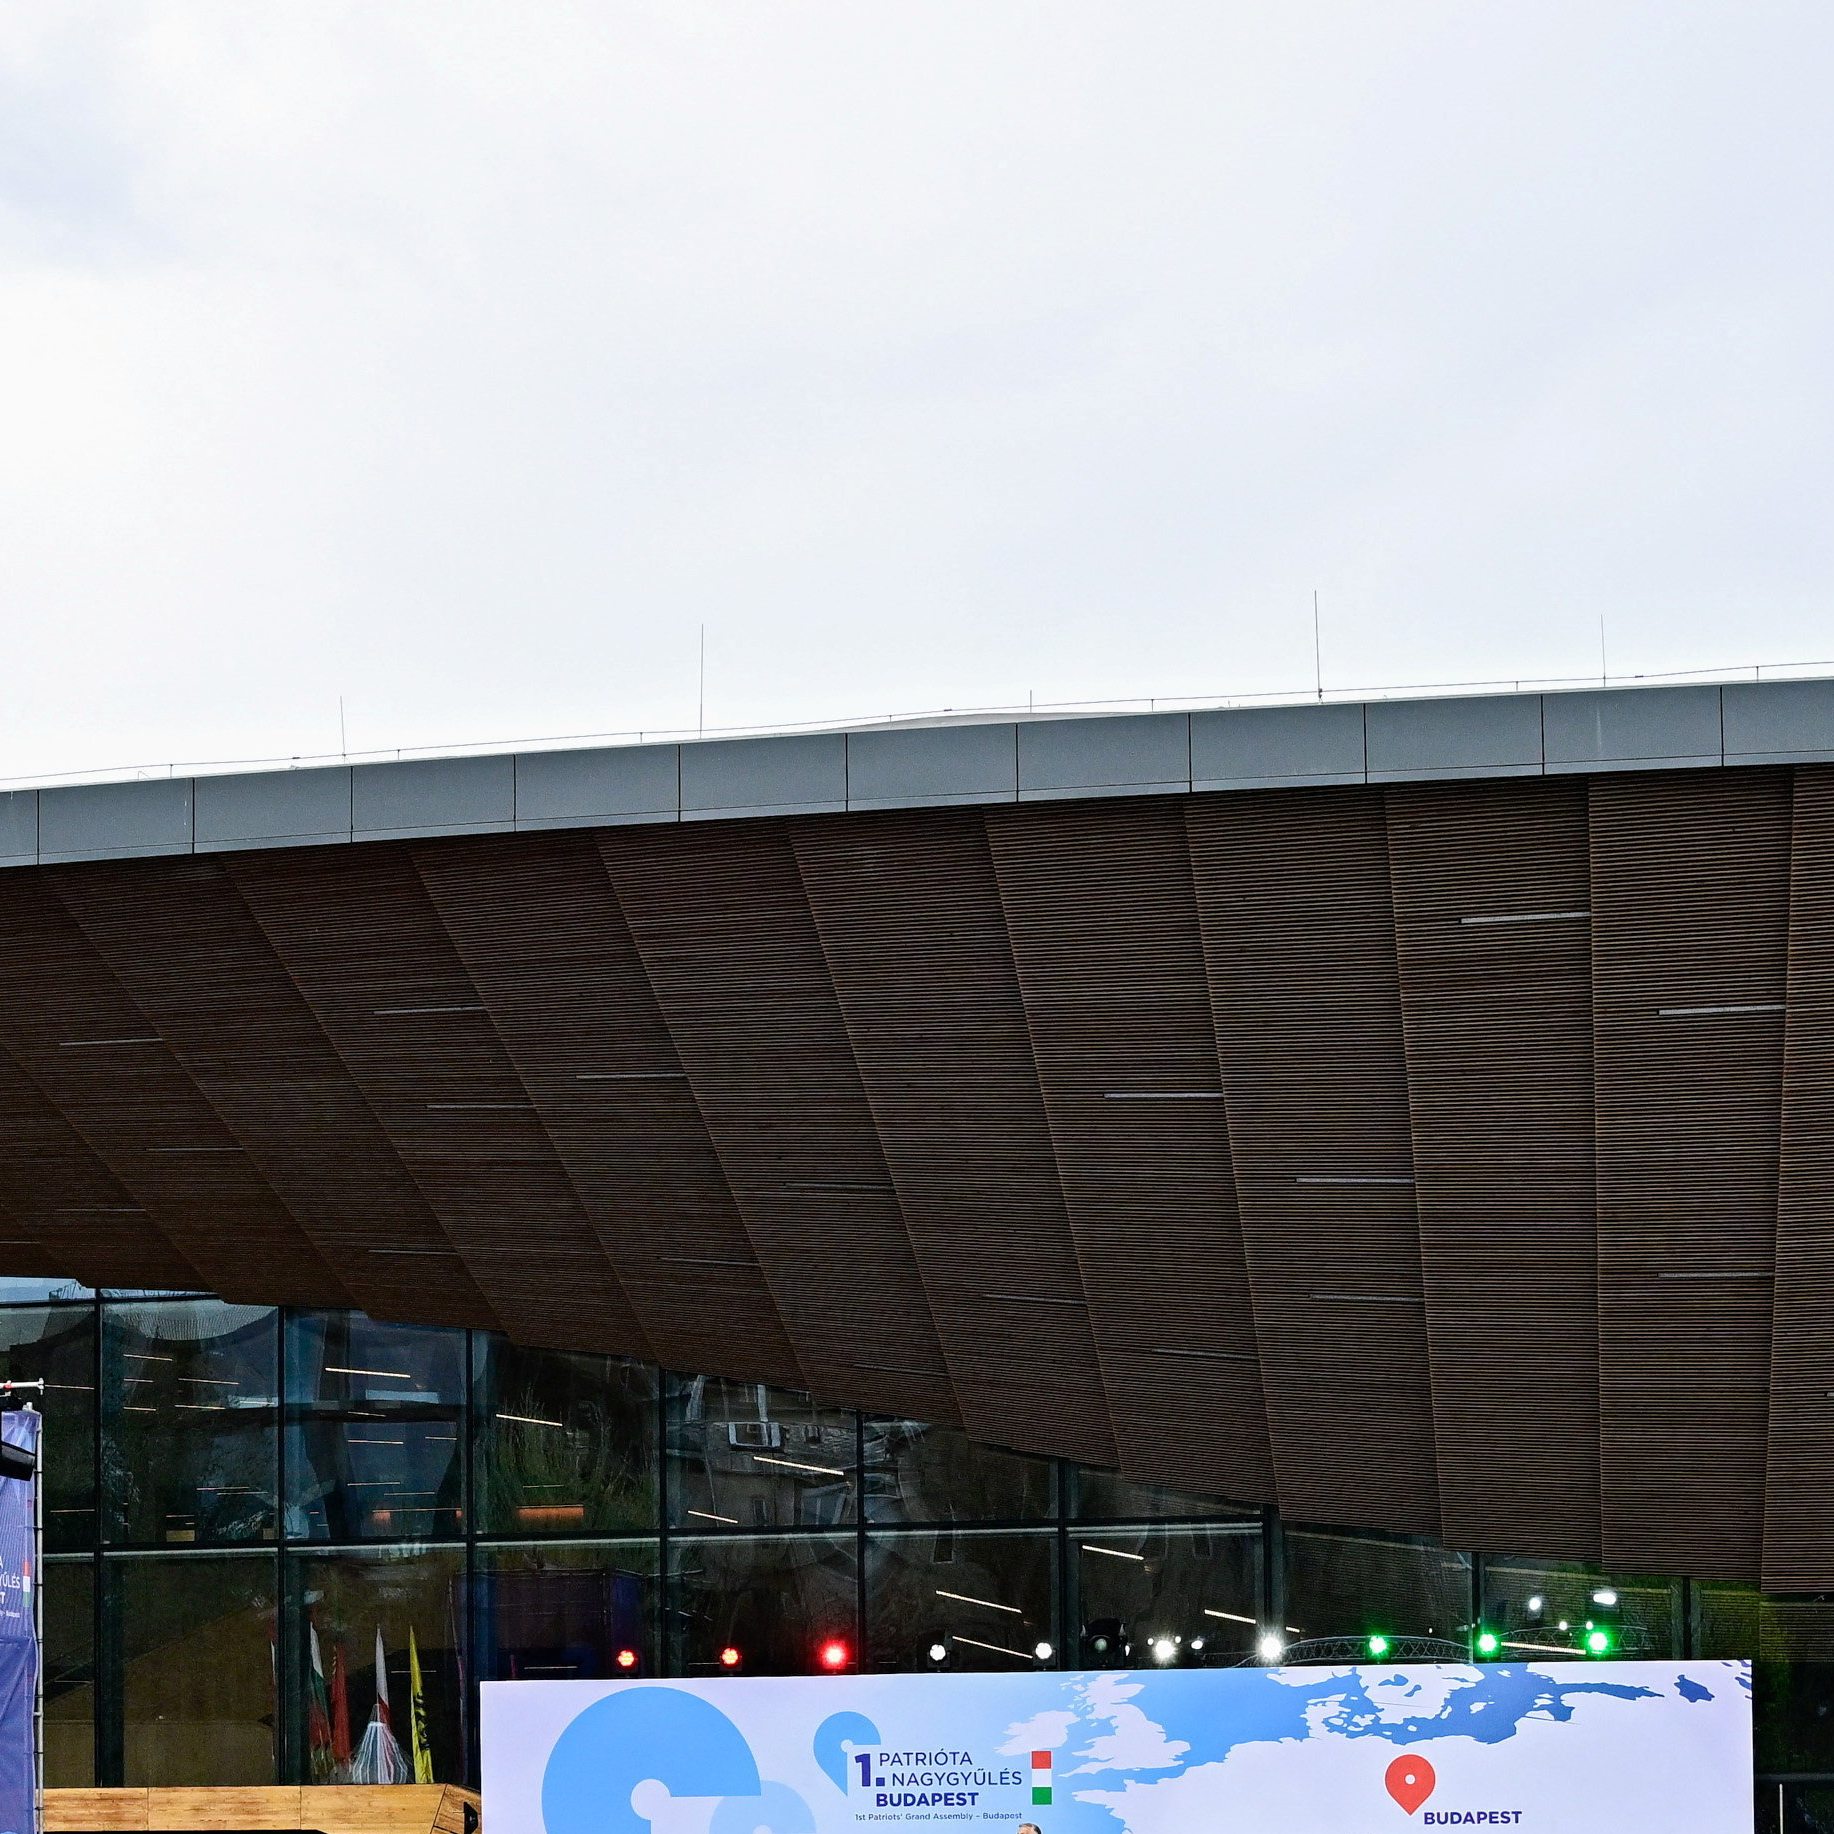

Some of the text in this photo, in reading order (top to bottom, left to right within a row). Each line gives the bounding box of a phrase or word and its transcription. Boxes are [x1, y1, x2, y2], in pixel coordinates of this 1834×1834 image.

[854, 1748, 973, 1787] 1. PATRIÓTA
[892, 1768, 1022, 1787] NAGYGYŰLÉS
[876, 1792, 979, 1807] BUDAPEST
[905, 1813, 931, 1821] Grand
[933, 1812, 973, 1822] Assembly
[982, 1812, 1022, 1820] Budapest
[1424, 1811, 1523, 1825] BUDAPEST
